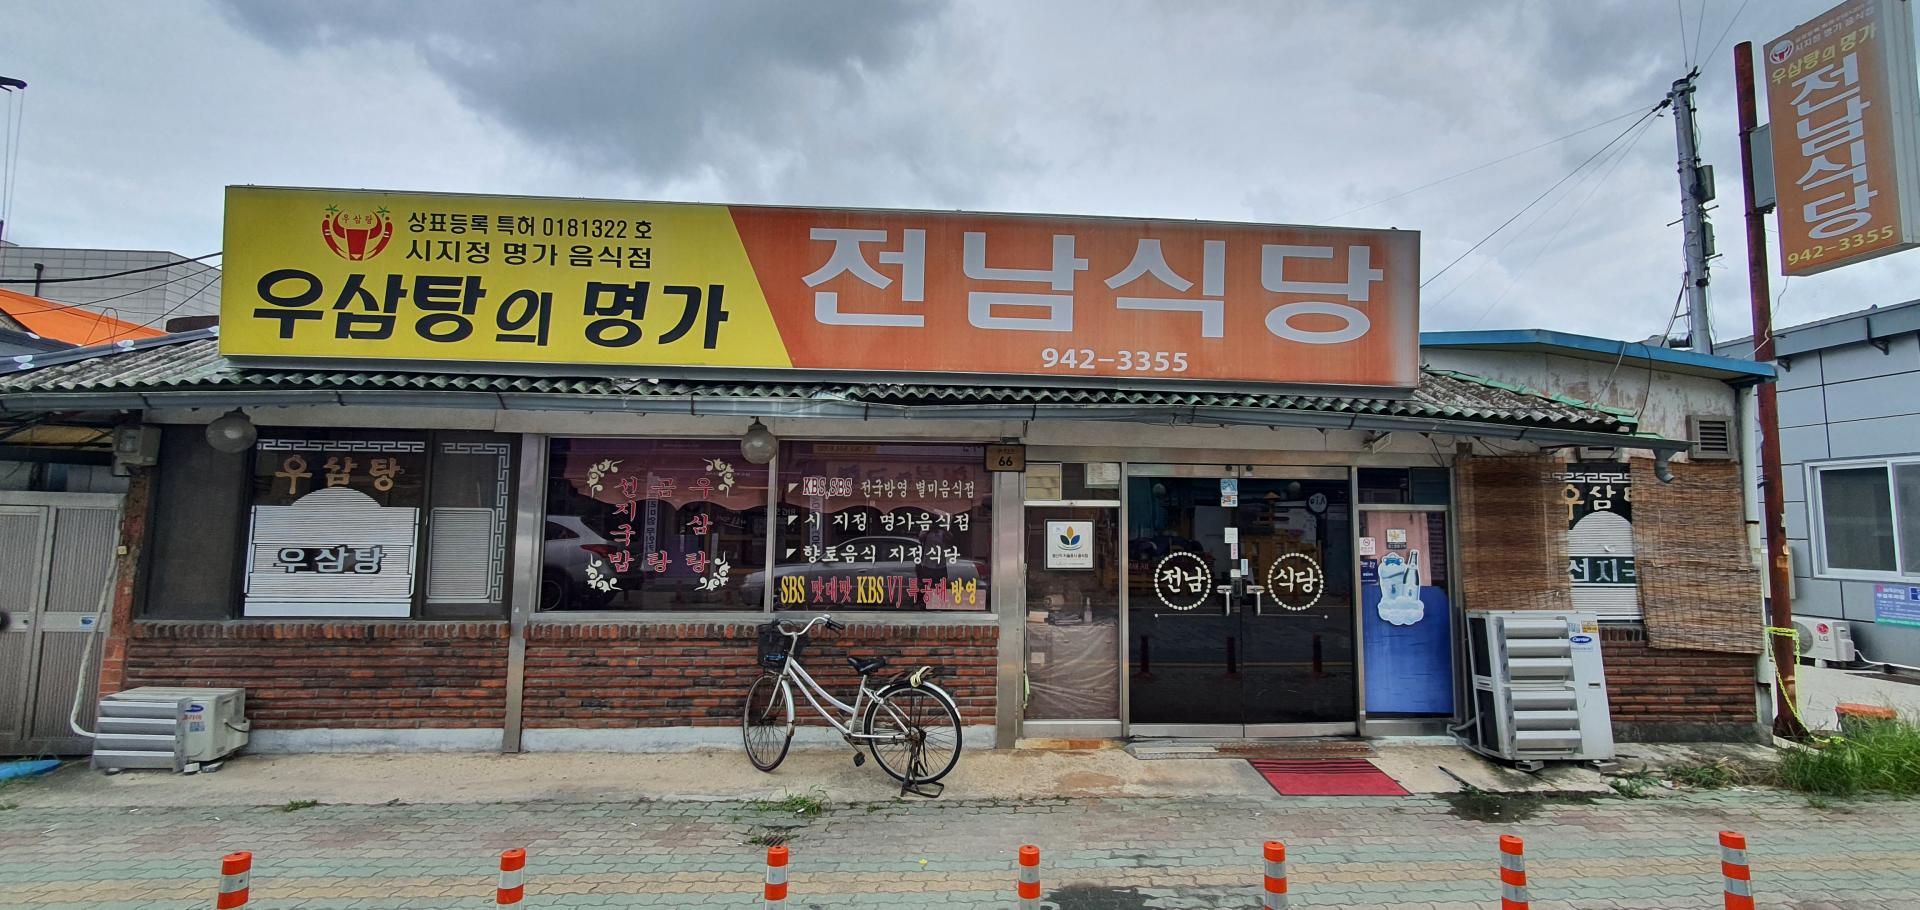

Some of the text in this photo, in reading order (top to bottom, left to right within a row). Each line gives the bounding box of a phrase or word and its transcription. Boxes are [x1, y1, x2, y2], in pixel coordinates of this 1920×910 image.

[1772, 22, 1877, 84] 우삼탕의 명가
[1790, 52, 1879, 239] 전남식당
[408, 212, 652, 239] 상표등록 특허 0181322 호
[406, 240, 651, 269] 시지정 명가 음식점
[1787, 225, 1894, 265] 942-3355
[802, 227, 1383, 344] 전남식당
[253, 269, 729, 349] 우삼탕의 명가
[1041, 347, 1189, 372] 942-3355
[274, 454, 405, 494] 우삼탕
[998, 456, 1014, 467] 66
[860, 479, 907, 498] 전국방영
[916, 480, 975, 499] 별미음식점
[608, 476, 639, 573] 선지국밥
[686, 477, 715, 573] 우삼탕
[804, 512, 970, 532] 시 지정 명가음식점
[273, 544, 387, 574] 우삼탕
[803, 544, 961, 565] 향토음식 지정식당
[781, 575, 977, 608] SBS 맛대맛 KBS VJ 특공대 방영
[1161, 566, 1207, 593] 전남
[1274, 566, 1318, 593] 식당
